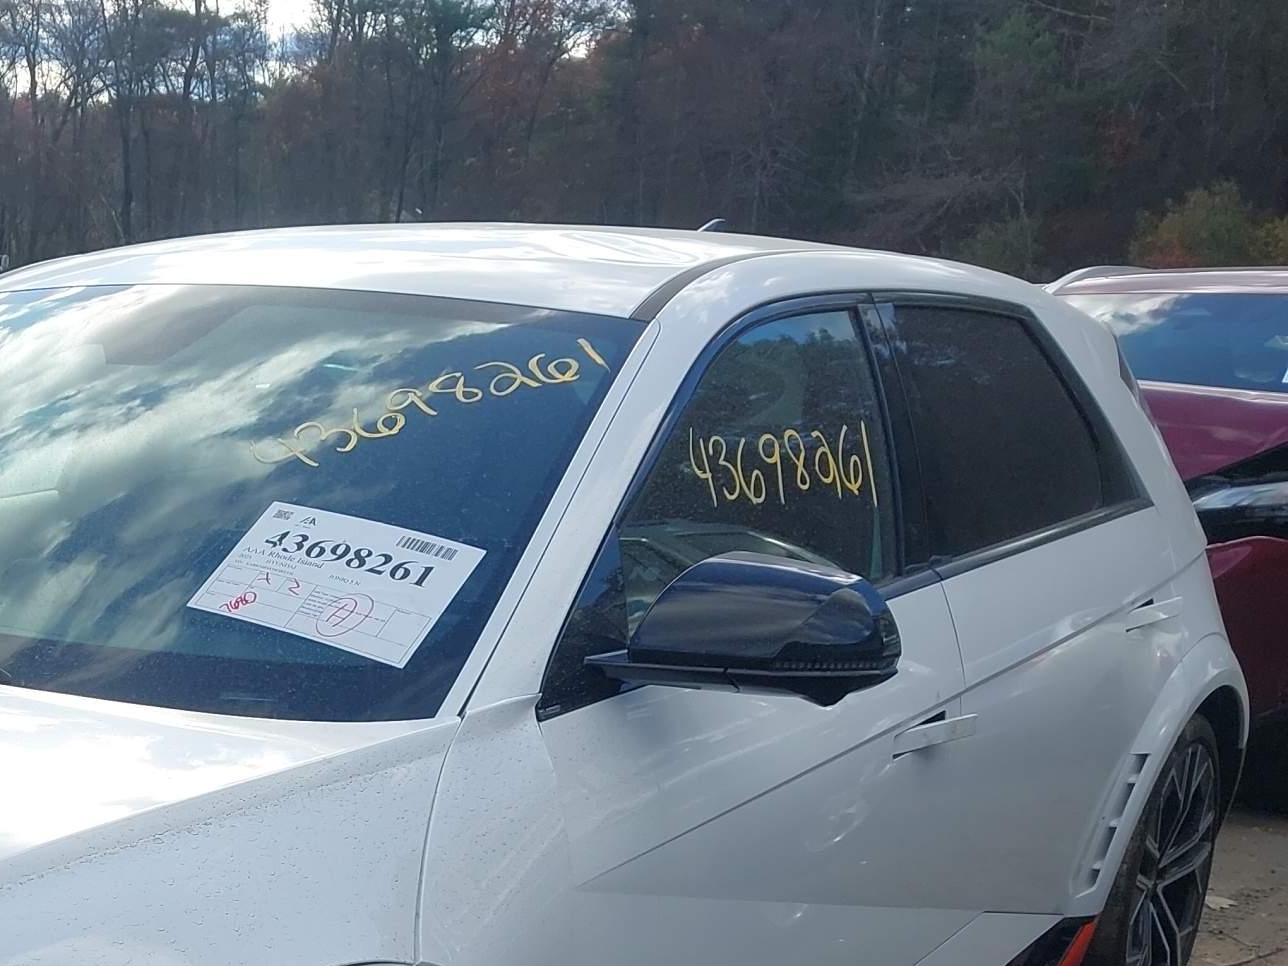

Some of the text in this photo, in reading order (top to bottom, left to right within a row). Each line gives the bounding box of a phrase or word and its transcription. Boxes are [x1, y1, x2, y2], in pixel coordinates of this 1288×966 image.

[249, 337, 611, 468] 43698261
[689, 420, 878, 508] 43698261
[264, 530, 435, 589] 43698261
[267, 550, 295, 561] Rhode
[297, 557, 325, 569] Island
